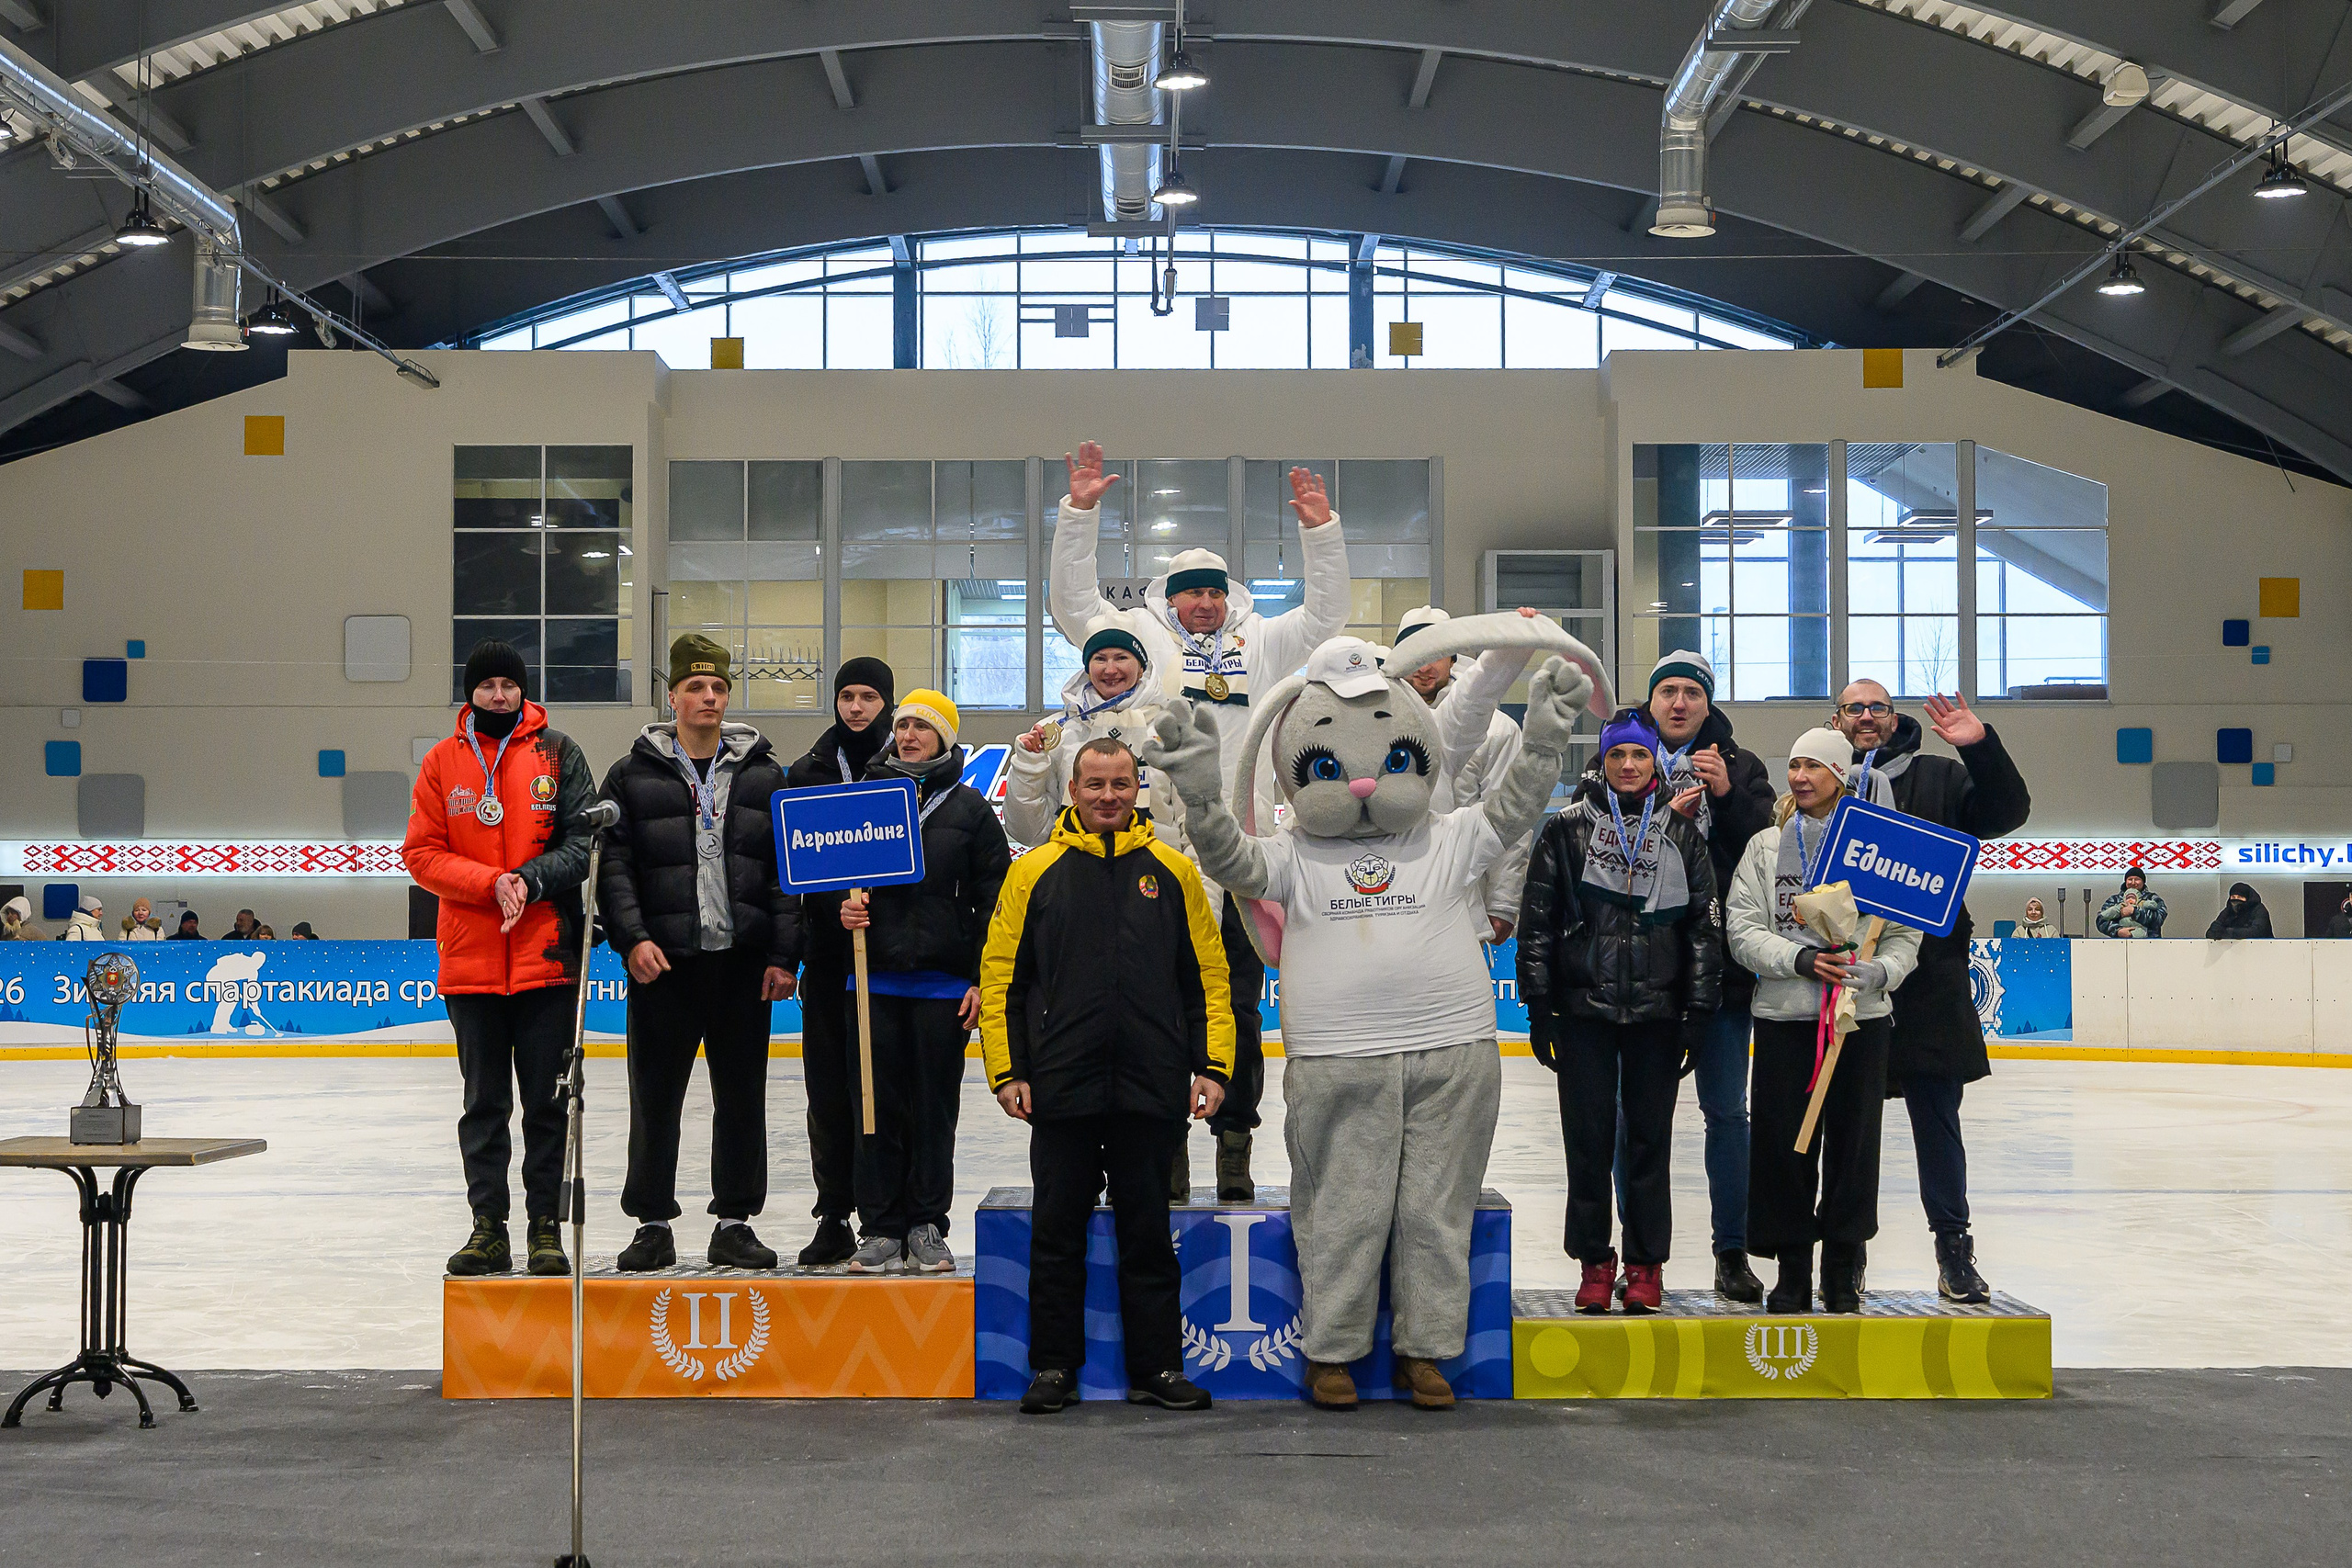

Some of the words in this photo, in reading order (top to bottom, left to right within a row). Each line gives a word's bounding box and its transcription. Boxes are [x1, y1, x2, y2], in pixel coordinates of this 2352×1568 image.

[530, 804, 557, 812] BELARUS
[791, 821, 905, 853] Агрохолдинг
[1843, 838, 1945, 895] Единые
[1329, 897, 1372, 909] БЕЛЫЕ
[1374, 893, 1416, 907] ТИГРЫ
[52, 975, 176, 1005] Зияя
[185, 979, 390, 1010] спартакиада
[1213, 1214, 1267, 1332] I
[681, 1292, 739, 1349] II
[1756, 1325, 1809, 1359] III
